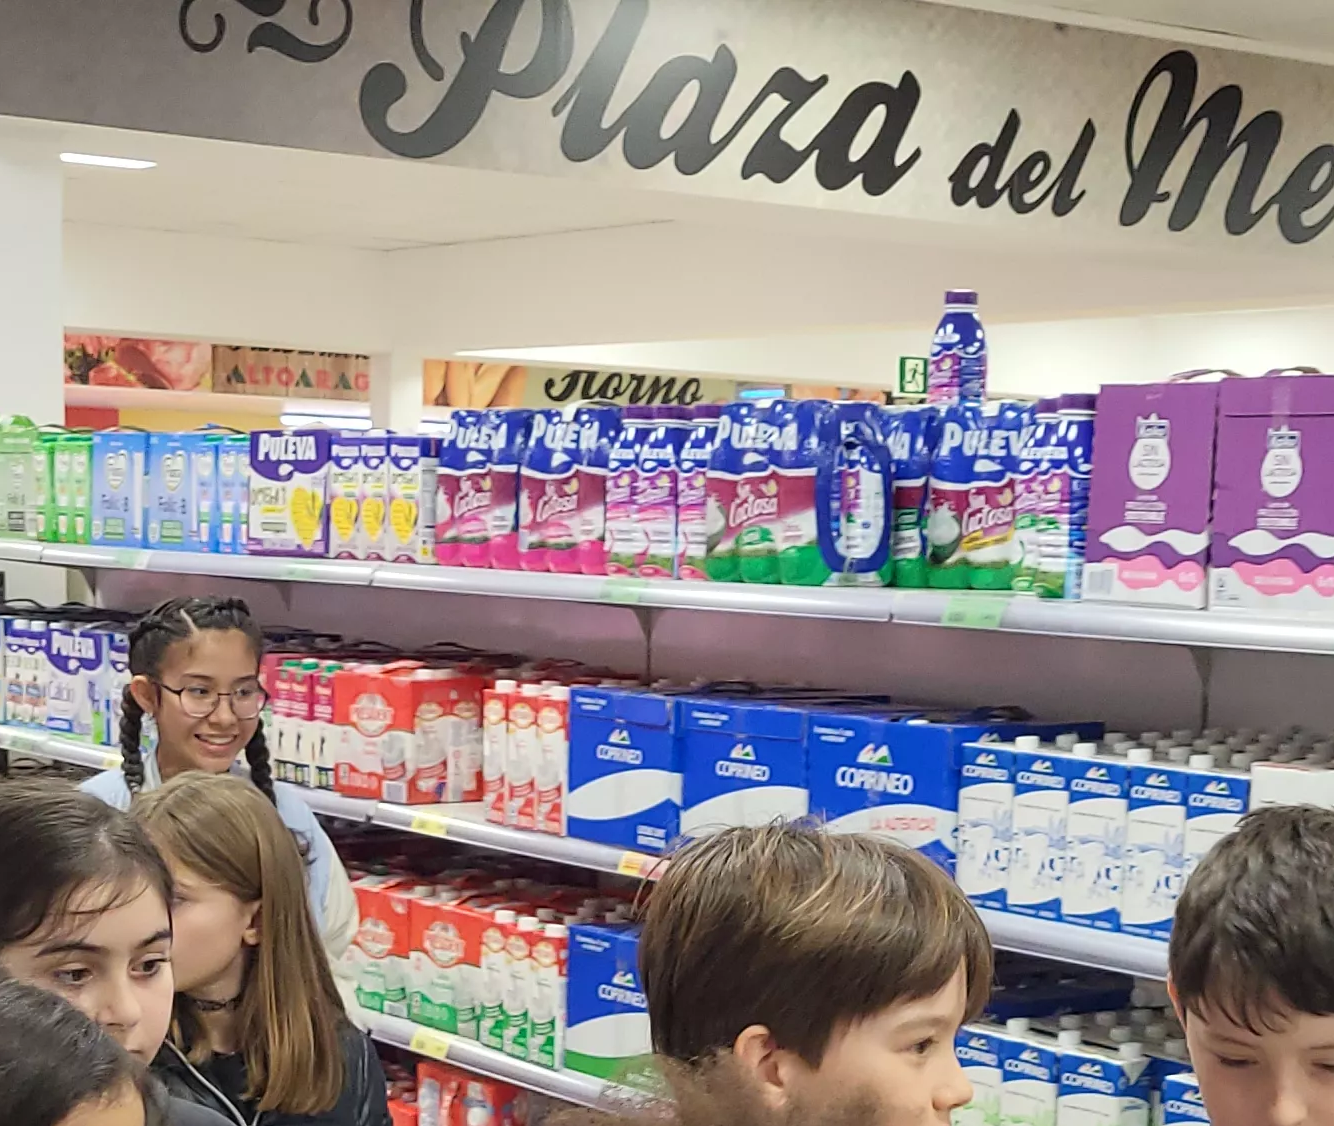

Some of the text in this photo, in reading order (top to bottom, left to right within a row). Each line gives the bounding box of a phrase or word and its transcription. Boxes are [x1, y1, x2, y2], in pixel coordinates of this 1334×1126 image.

[359, 0, 921, 196] Plaza
[949, 109, 1096, 217] del
[257, 432, 316, 461] PULEVA
